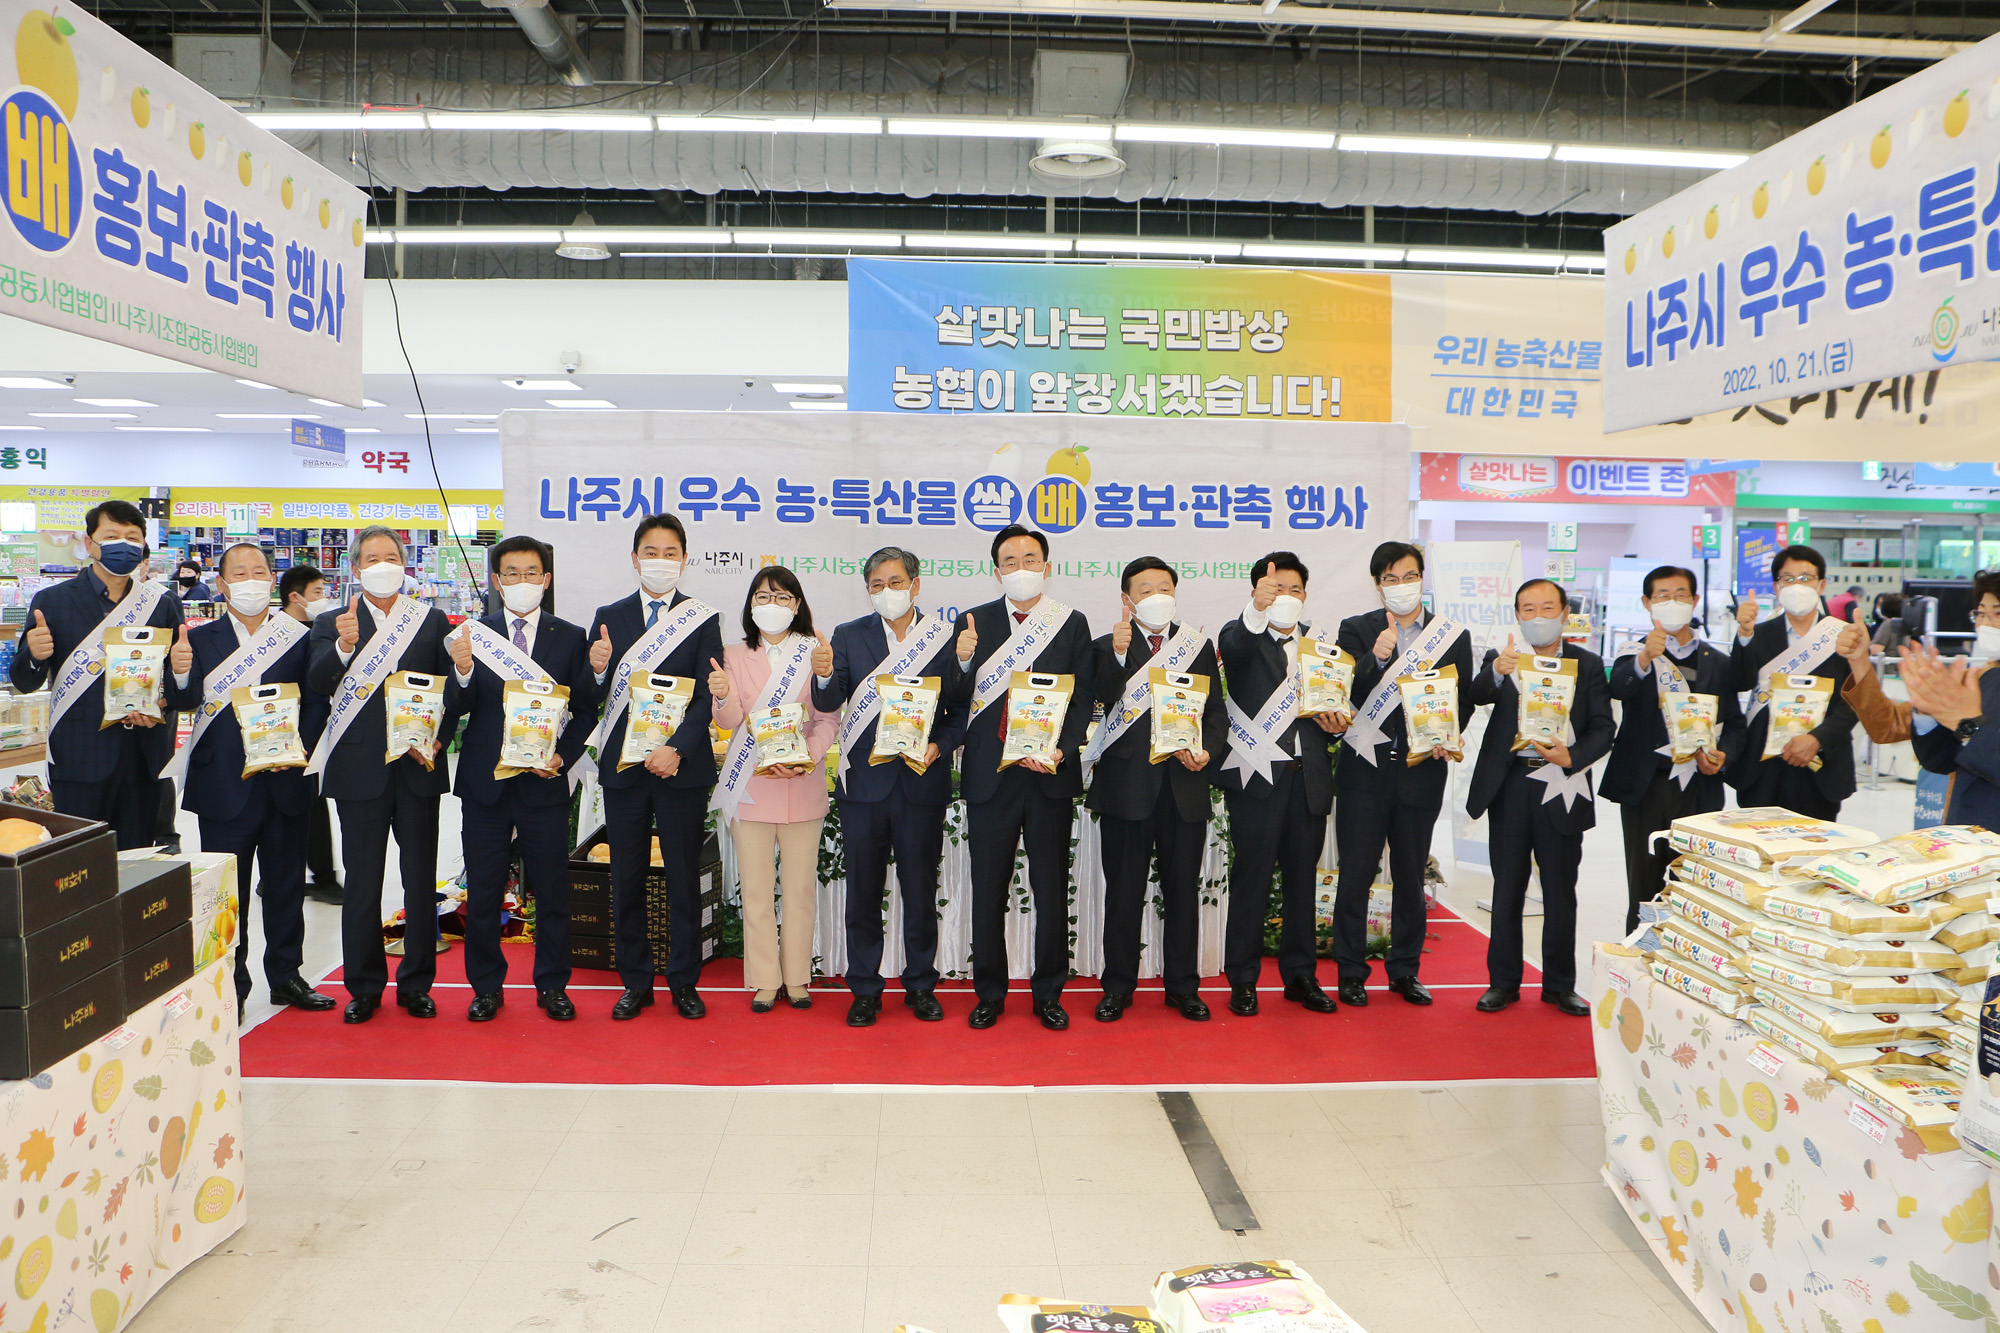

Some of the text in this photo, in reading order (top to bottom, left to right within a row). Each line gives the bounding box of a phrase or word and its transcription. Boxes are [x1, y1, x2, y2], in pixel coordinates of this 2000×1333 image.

[7, 100, 346, 343] 배 홍보·판촉 행사
[1626, 262, 1725, 369] 나주시
[1739, 229, 1827, 340] 우수
[935, 304, 1290, 353] 살맛나는 국민밥상
[1982, 306, 2000, 332] 나
[1432, 335, 1601, 372] 우리 농축산물
[1723, 339, 1854, 397] 2022. 10. 21.(금)
[892, 365, 1343, 418] 농협이 앞장서겠습니다!
[0, 446, 47, 471] 홍익
[361, 450, 411, 474] 약국
[1469, 461, 1686, 493] 살맛나는 이벤트 존
[230, 508, 246, 521] 11
[282, 502, 354, 520] 일반의약품,
[359, 503, 444, 521] 건강기능식품,
[539, 476, 1369, 531] 나주시 우수 농·특산물 쌀 배 홍보·판촉 행사
[1564, 525, 1573, 538] 5
[1706, 528, 1717, 546] 3
[1792, 526, 1806, 545] 4
[705, 551, 743, 567] 나주시
[395, 613, 412, 635] 우수
[676, 608, 698, 626] 우수
[471, 633, 492, 650] 우수
[924, 622, 942, 641] 우수
[1029, 618, 1051, 644] 나주시
[1811, 634, 1831, 652] 우수
[256, 635, 278, 657] 우수
[792, 643, 809, 664] 우수
[1015, 634, 1036, 656] 우수
[1168, 646, 1188, 667] 우수
[142, 896, 169, 921] 나주배
[60, 935, 92, 963] 나주배
[144, 957, 169, 983] 나주배
[64, 1001, 95, 1031] 나주배
